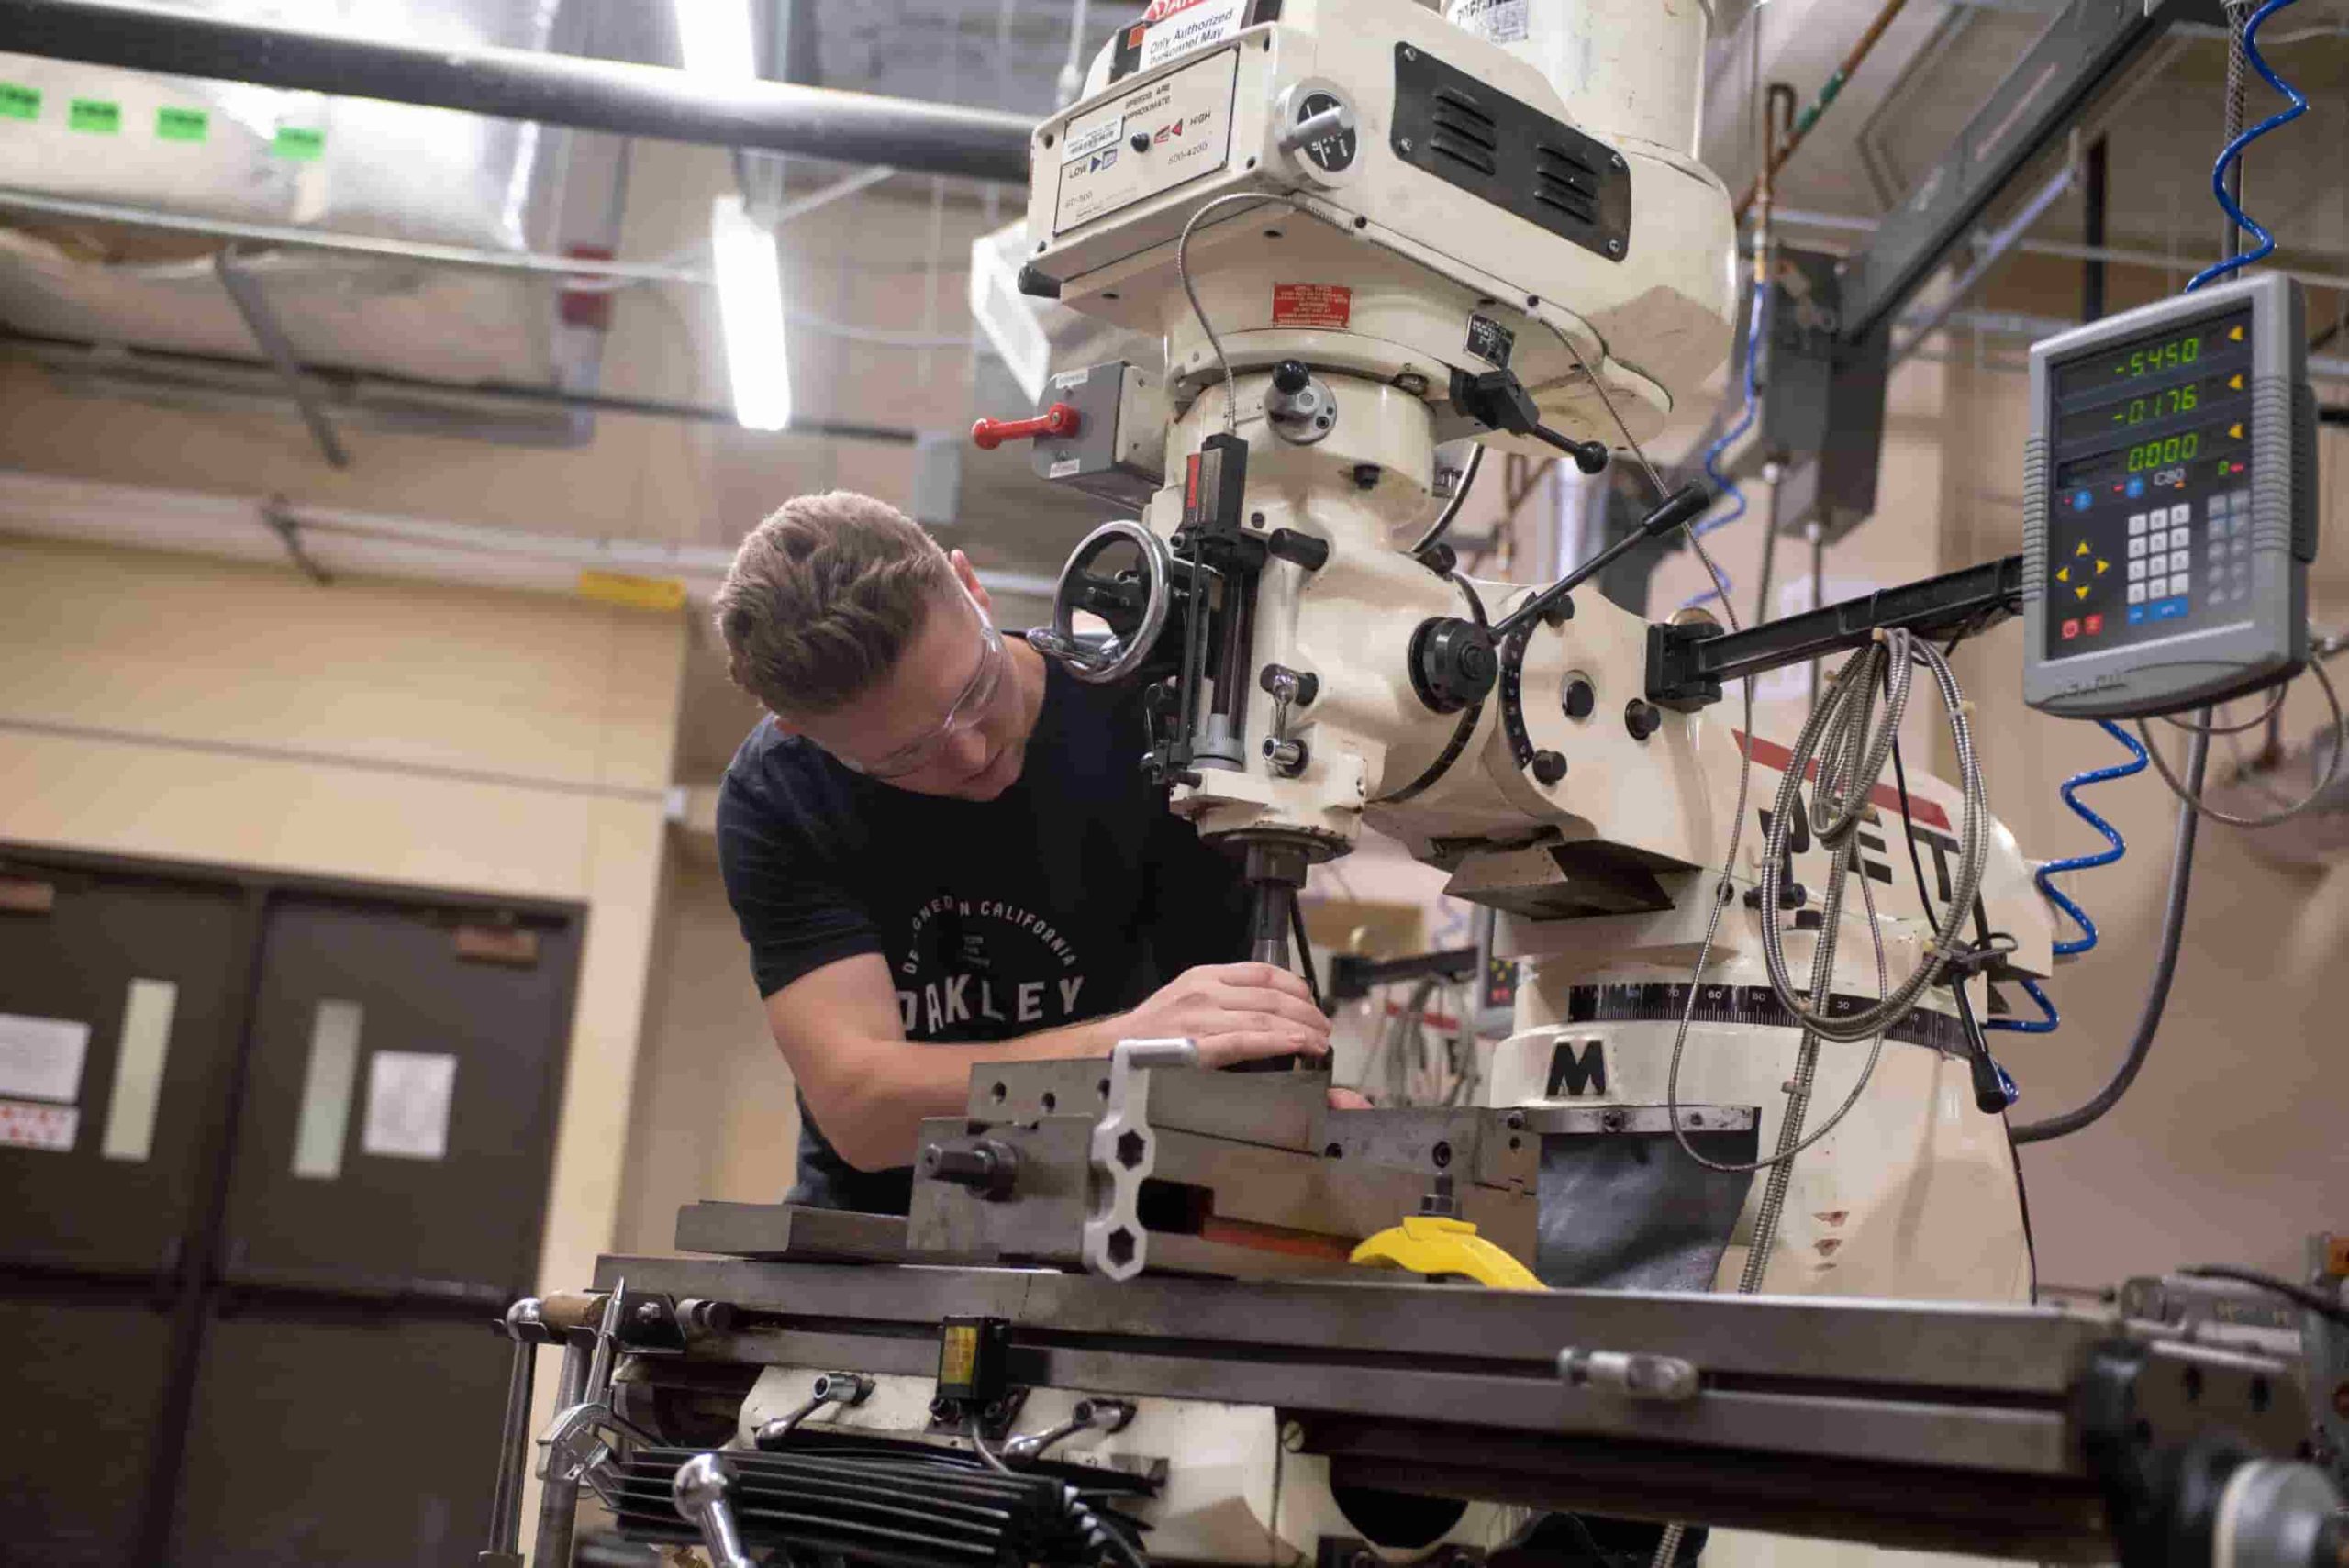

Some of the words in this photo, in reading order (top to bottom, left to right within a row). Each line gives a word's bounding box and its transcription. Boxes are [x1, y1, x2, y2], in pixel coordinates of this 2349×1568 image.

[1174, 8, 1233, 39] Authorized
[1189, 110, 1211, 126] HIGH
[1068, 163, 1087, 179] LOW
[980, 900, 1078, 966] CALIFORNIA
[1544, 1040, 1606, 1095] M
